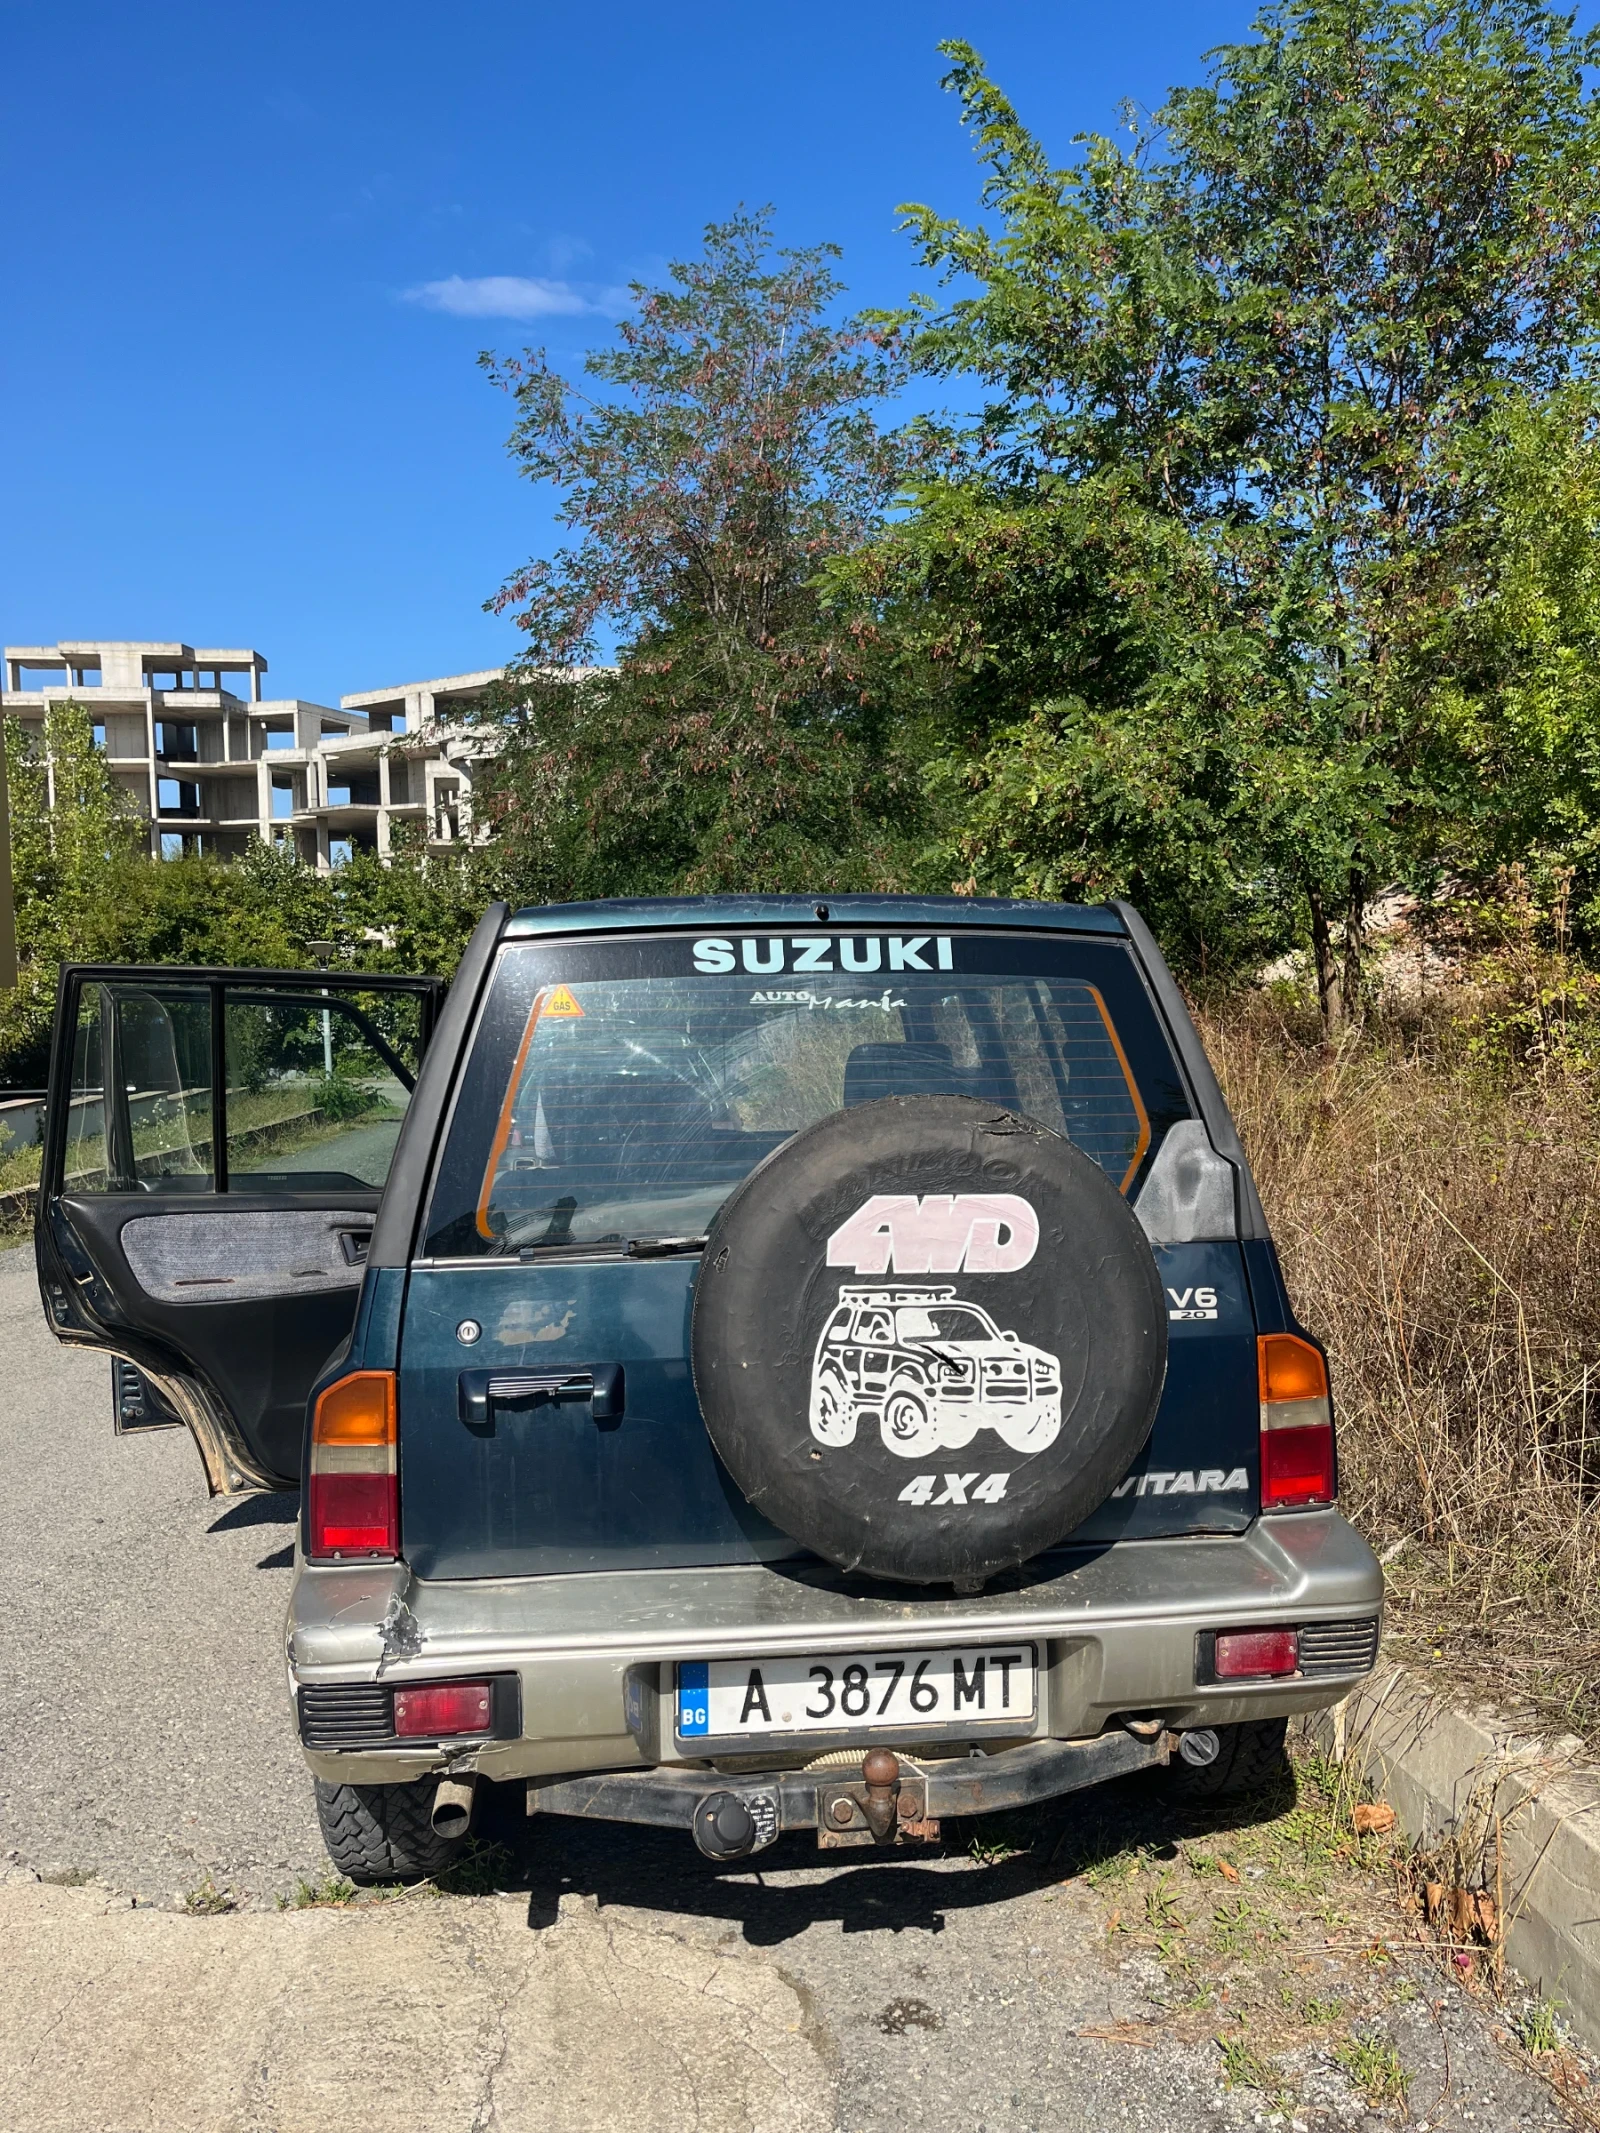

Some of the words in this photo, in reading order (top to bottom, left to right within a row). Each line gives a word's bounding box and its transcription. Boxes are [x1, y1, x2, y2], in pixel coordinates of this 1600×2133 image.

[692, 937, 954, 974] SUZUKI
[553, 1001, 571, 1011] GAS
[750, 991, 811, 1003] AUTO
[808, 989, 907, 1012] Mania
[826, 1194, 1040, 1274] 4WD
[1166, 1287, 1218, 1309] V6
[897, 1472, 1011, 1506] 4X4
[739, 1668, 772, 1723] A
[805, 1659, 939, 1719] 3876
[953, 1655, 1022, 1711] MT
[682, 1709, 706, 1725] BG
